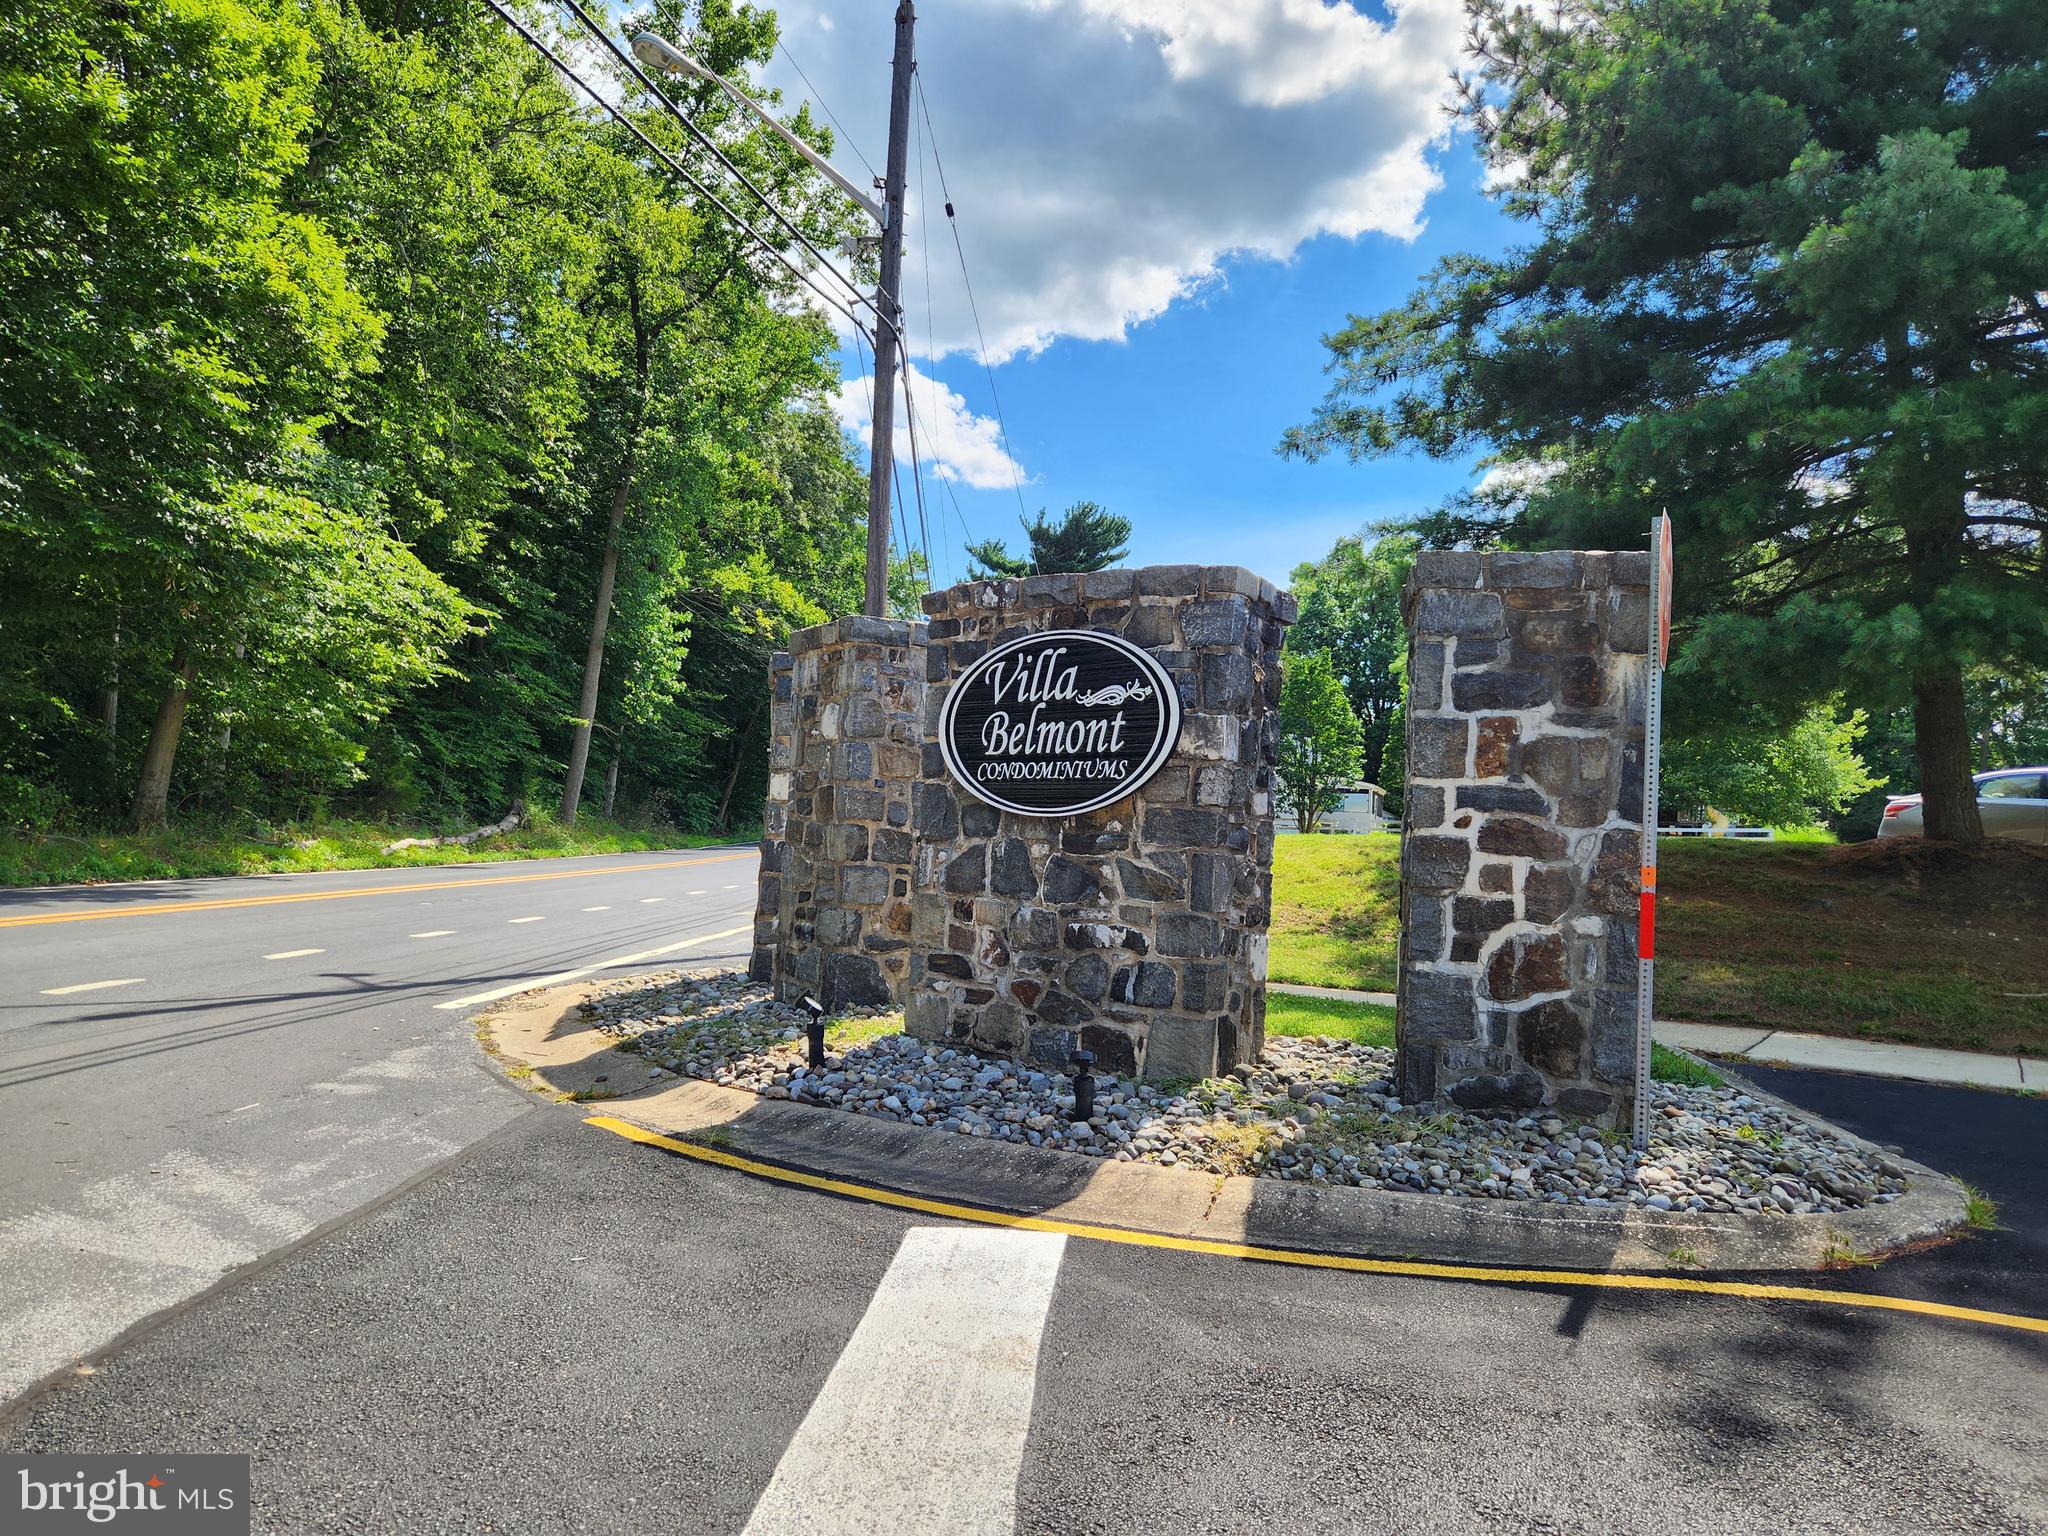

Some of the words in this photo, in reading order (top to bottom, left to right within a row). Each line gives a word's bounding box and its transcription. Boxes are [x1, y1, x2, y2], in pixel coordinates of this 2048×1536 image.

[985, 647, 1078, 705] Villa
[982, 702, 1126, 755] Belmont
[978, 759, 1127, 781] CONDOMINIUMS
